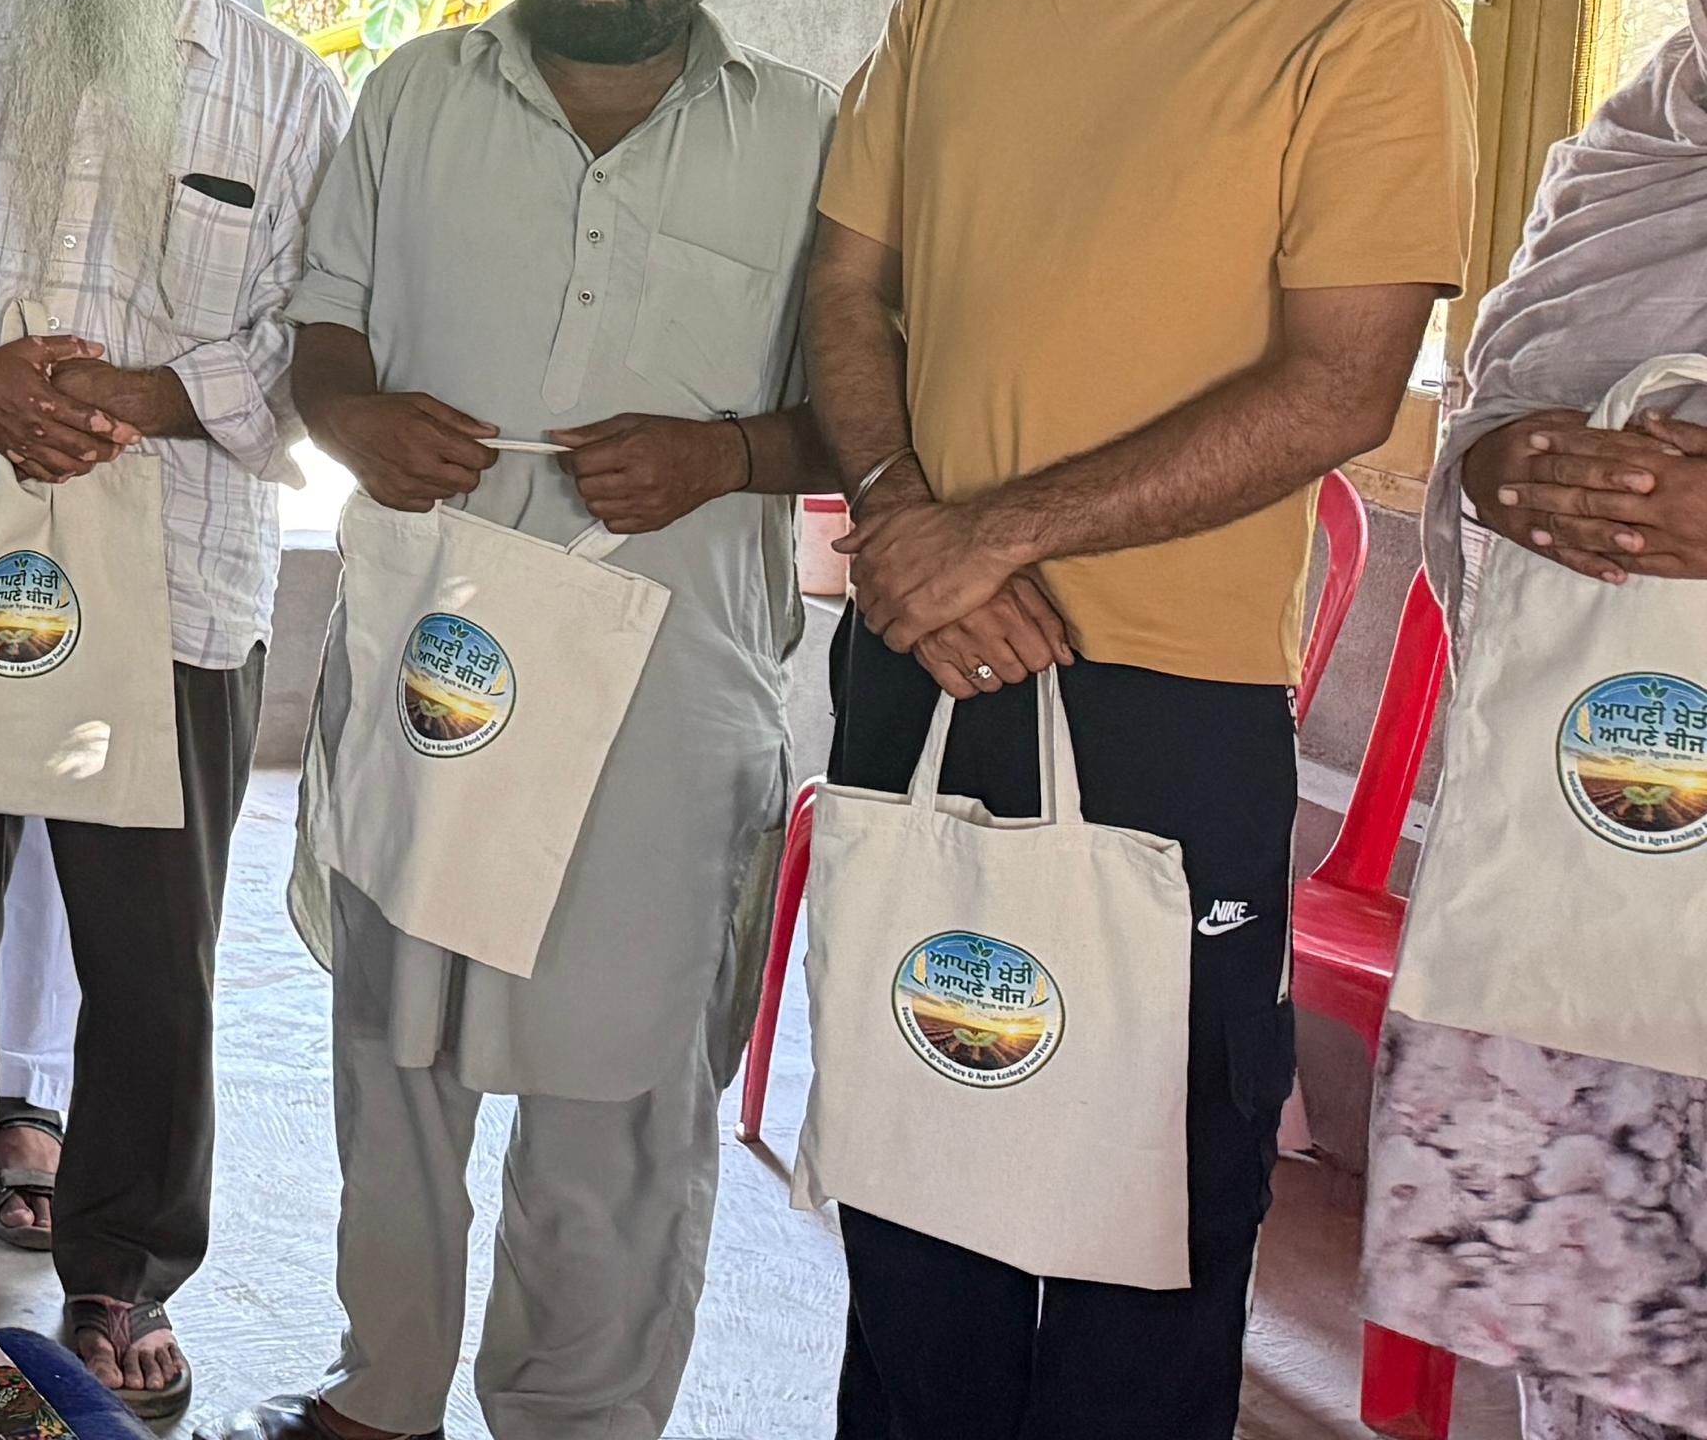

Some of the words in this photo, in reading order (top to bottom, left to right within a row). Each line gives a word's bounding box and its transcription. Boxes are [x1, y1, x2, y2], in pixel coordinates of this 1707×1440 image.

[32, 569, 59, 589] ਖੇਤੀ
[26, 588, 53, 605] ਬੀਜ
[467, 646, 500, 674] ਖੇਤੀ
[455, 663, 486, 689] ਬੀਜ
[1592, 701, 1666, 724] ਆਪਣੀ
[1673, 702, 1707, 729] ਖੇਤ
[1599, 726, 1659, 747] ਆਪਣੇ
[1665, 728, 1706, 753] ਬੀਜ
[1209, 899, 1248, 921] NIKE
[930, 951, 991, 980] ਆਪਣੀ
[997, 962, 1033, 984] ਖੇਤੀ
[934, 973, 985, 997] ਆਪਣੇ
[991, 984, 1026, 1004] ਬੀਜ
